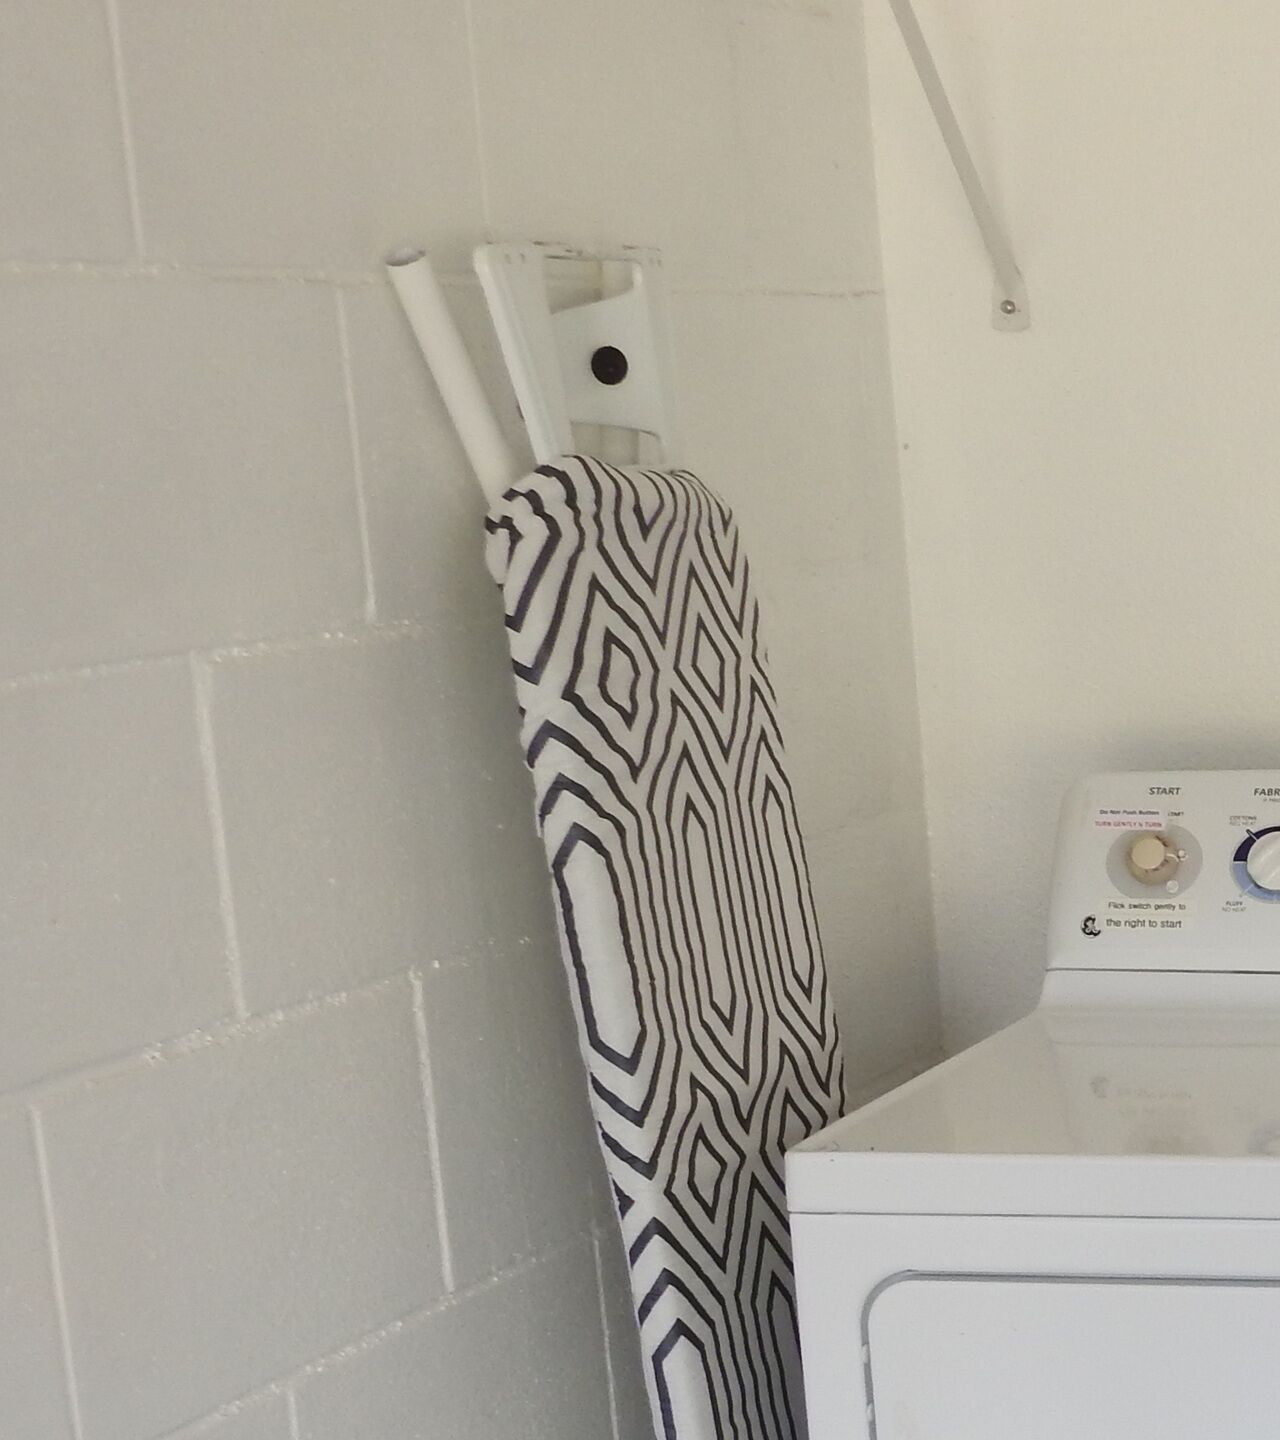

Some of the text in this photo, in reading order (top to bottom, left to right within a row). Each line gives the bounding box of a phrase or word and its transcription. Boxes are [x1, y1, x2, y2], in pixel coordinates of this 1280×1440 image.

[1149, 786, 1181, 796] START
[1154, 903, 1176, 912] gently
[1106, 918, 1182, 929] the right to start
